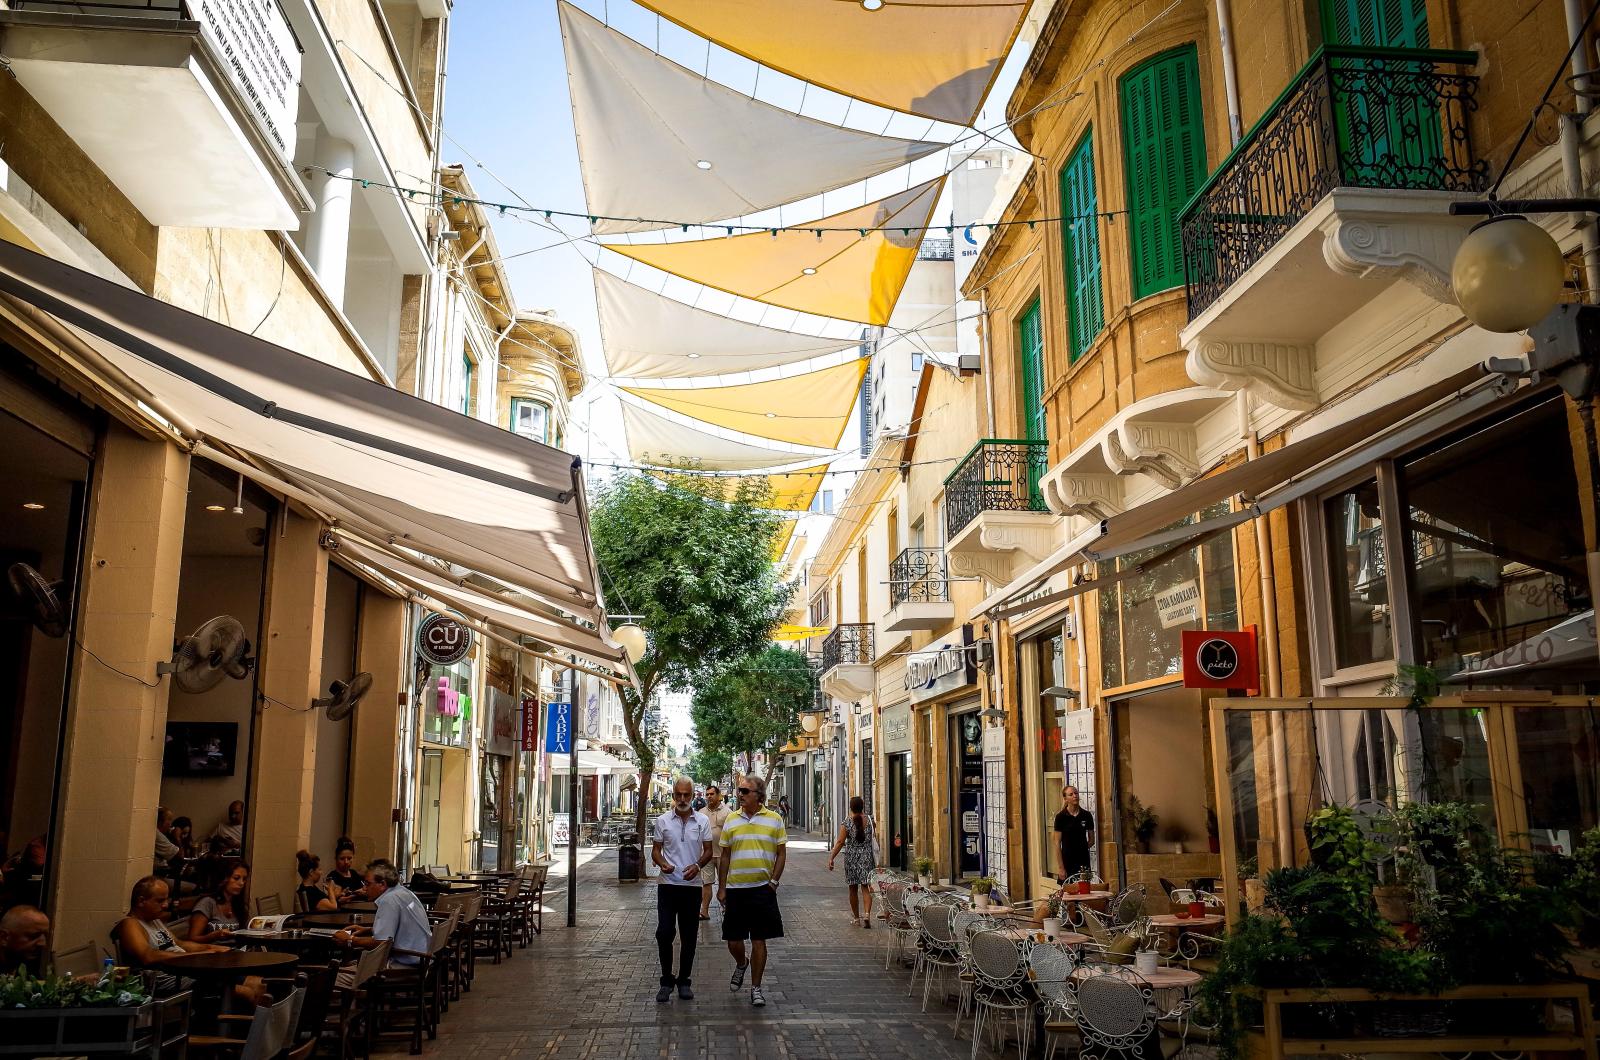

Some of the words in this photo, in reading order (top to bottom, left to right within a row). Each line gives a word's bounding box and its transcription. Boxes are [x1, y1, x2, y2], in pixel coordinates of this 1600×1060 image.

[202, 1, 216, 29] PRICE
[215, 25, 228, 47] ONLY
[225, 44, 234, 58] BY
[230, 56, 259, 103] APPOINTMENT
[256, 100, 268, 118] WITH
[264, 114, 274, 131] THE
